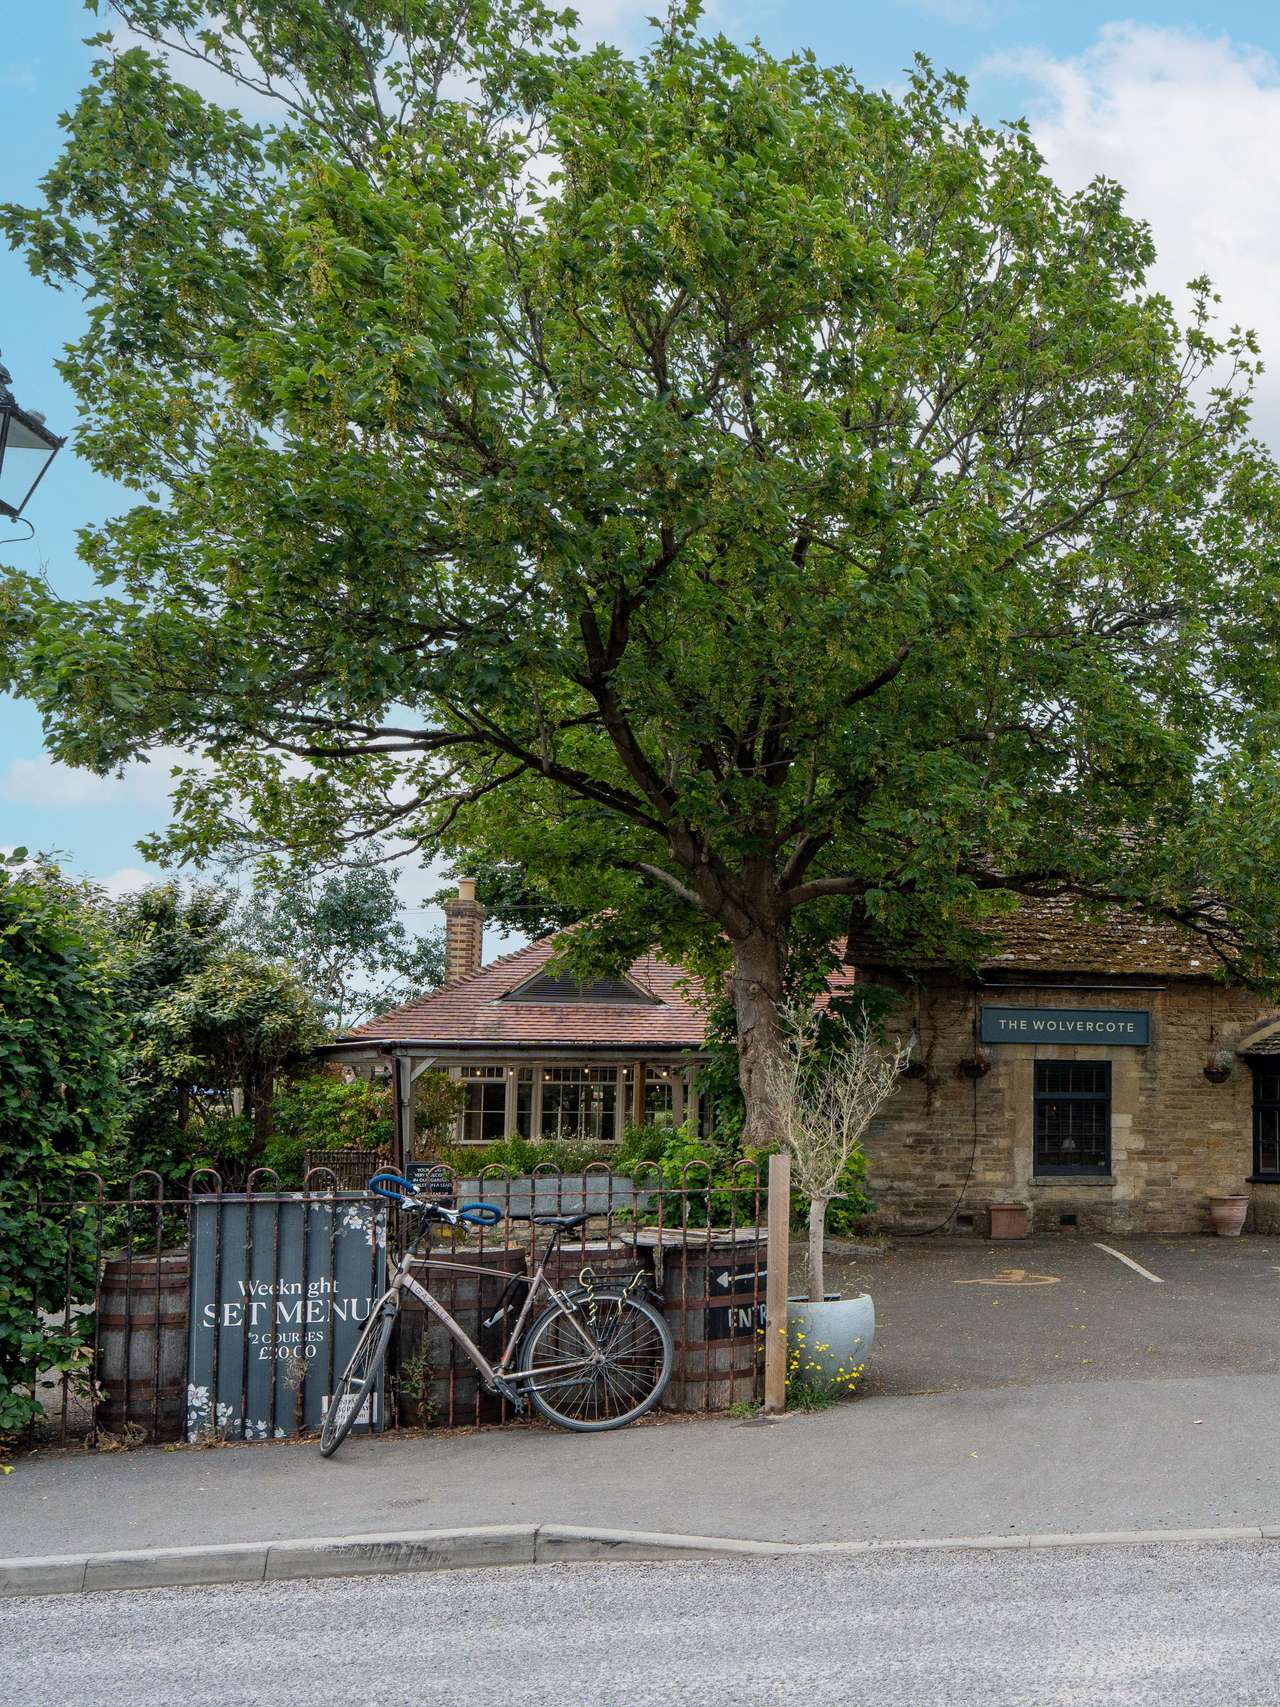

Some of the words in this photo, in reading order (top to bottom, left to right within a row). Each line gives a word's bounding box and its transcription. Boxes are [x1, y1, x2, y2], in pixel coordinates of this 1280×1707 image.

[999, 1019, 1028, 1031] THE
[1033, 1020, 1135, 1033] WOLVERCOTE
[237, 1276, 341, 1298] Weeknght
[203, 1301, 267, 1328] SET
[276, 1298, 373, 1325] MENU
[251, 1333, 259, 1345] 2
[261, 1331, 324, 1345] COURES
